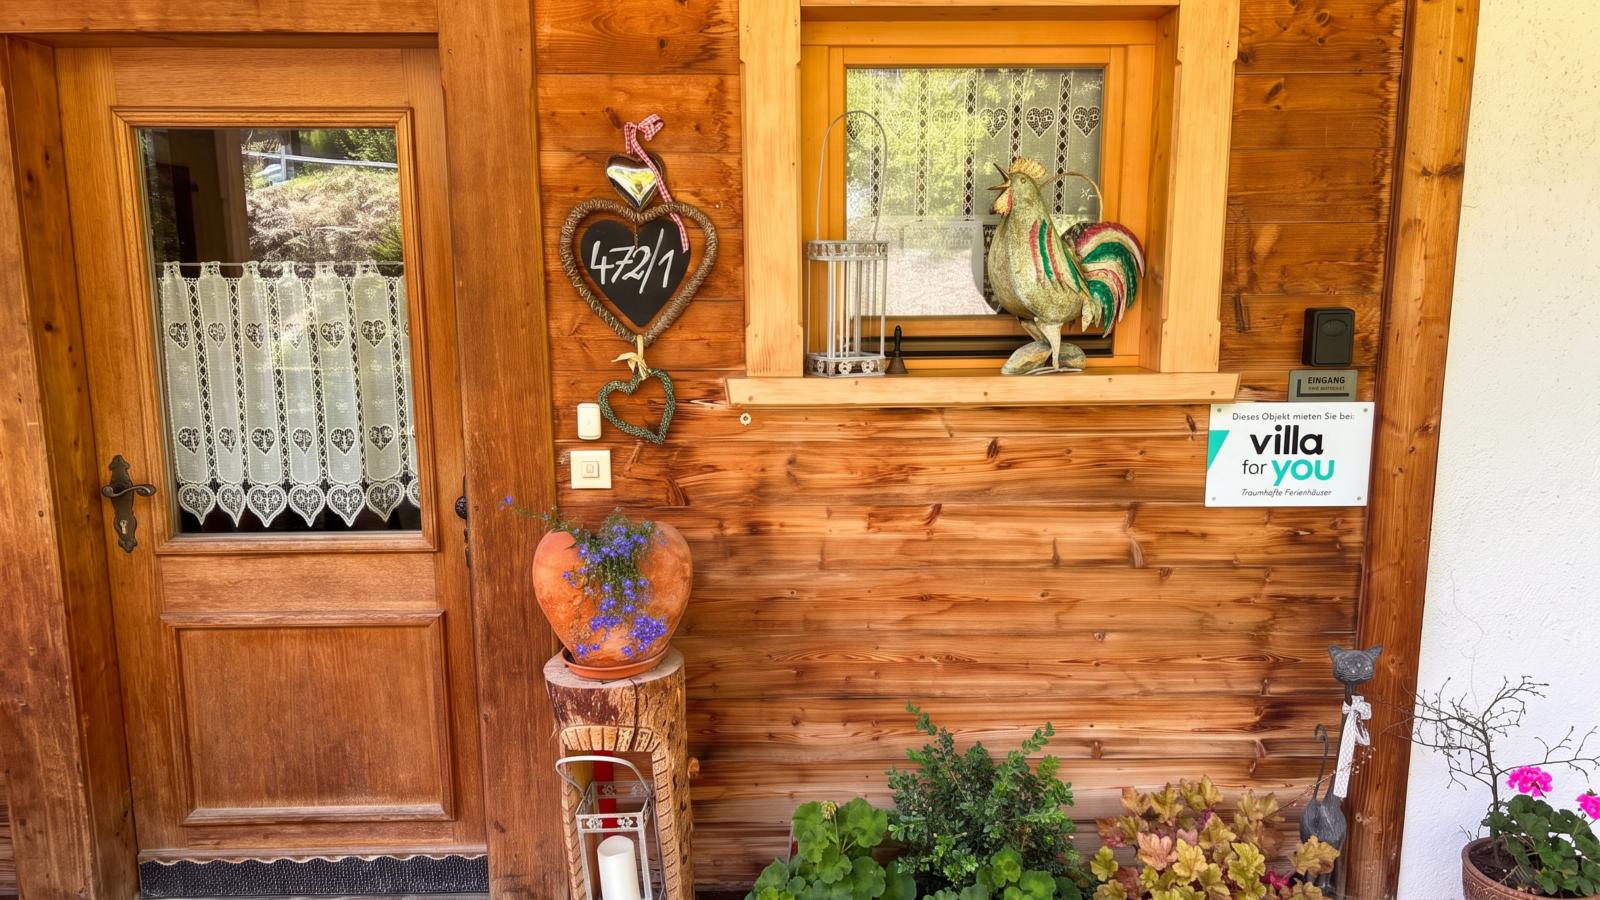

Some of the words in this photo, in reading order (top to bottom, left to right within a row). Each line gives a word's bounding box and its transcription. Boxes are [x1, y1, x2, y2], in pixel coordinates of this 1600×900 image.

[590, 228, 675, 294] 472/1
[1307, 376, 1345, 384] EINGANG
[1232, 412, 1260, 420] Dieses
[1261, 412, 1290, 422] Objekt
[1293, 412, 1322, 420] mieten
[1324, 412, 1337, 420] Sie
[1249, 424, 1324, 455] villa
[1242, 460, 1267, 475] for
[1272, 459, 1335, 486] you
[1241, 488, 1283, 497] Traumhafte
[1284, 488, 1332, 497] Ferienhäuser
